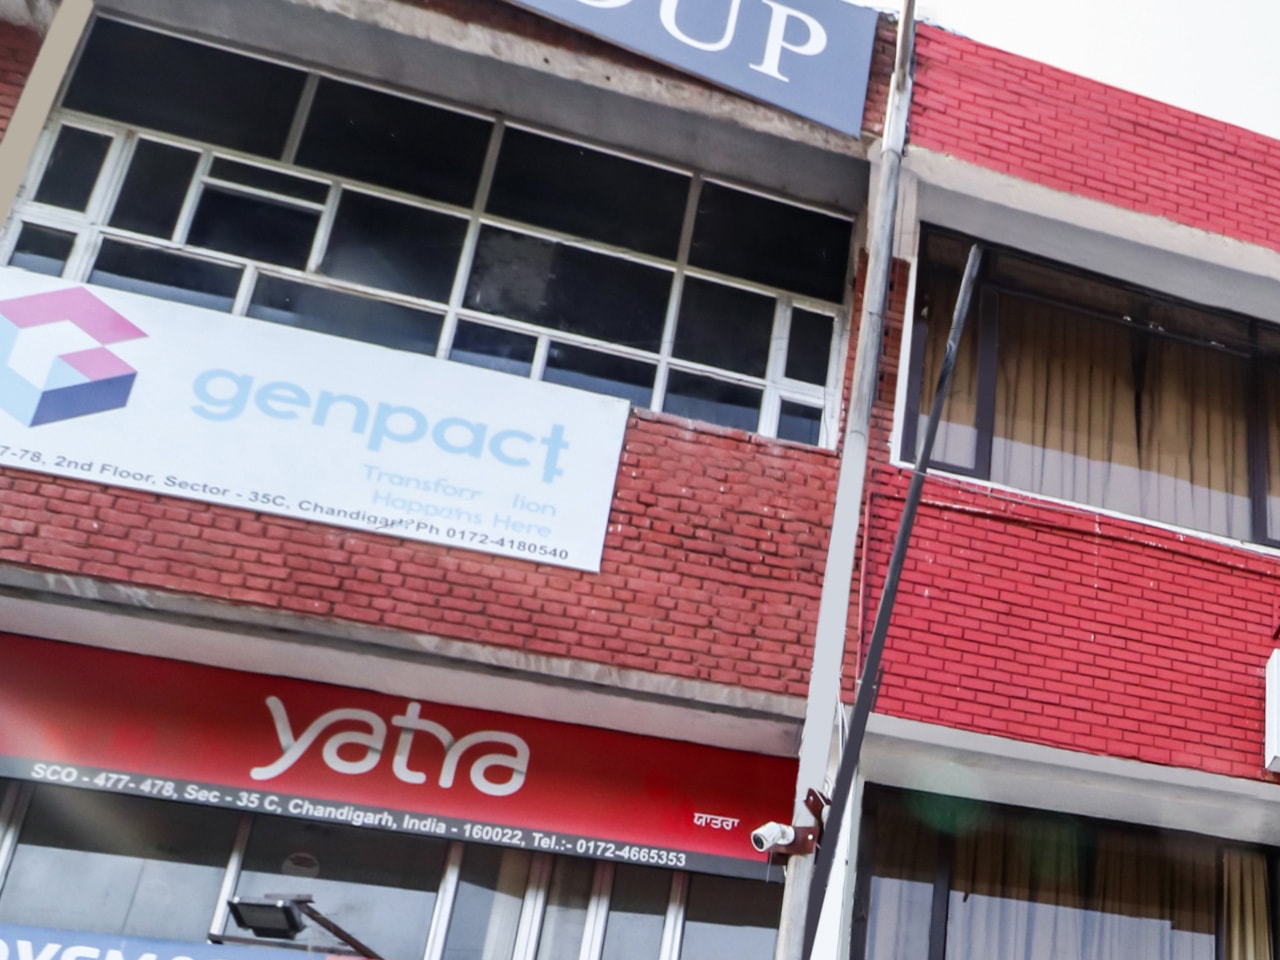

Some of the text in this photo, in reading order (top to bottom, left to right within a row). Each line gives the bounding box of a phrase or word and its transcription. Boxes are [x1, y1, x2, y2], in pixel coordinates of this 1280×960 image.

[574, 0, 827, 82] UP
[191, 367, 570, 485] genpact
[54, 455, 94, 473] 2nd
[163, 475, 231, 499] Sector
[416, 521, 440, 536] Ph
[446, 527, 569, 561] 0172-4180540
[493, 512, 552, 538] Here
[250, 695, 531, 797] yatra
[31, 763, 79, 784] SCO
[140, 779, 178, 800] 478,
[184, 784, 220, 803] Sec
[236, 791, 260, 811] 35
[263, 793, 283, 814] C,
[288, 798, 398, 830] Chandigarh,
[402, 812, 447, 836] India
[462, 822, 526, 848] 160022,
[576, 838, 687, 868] 0172-4665353
